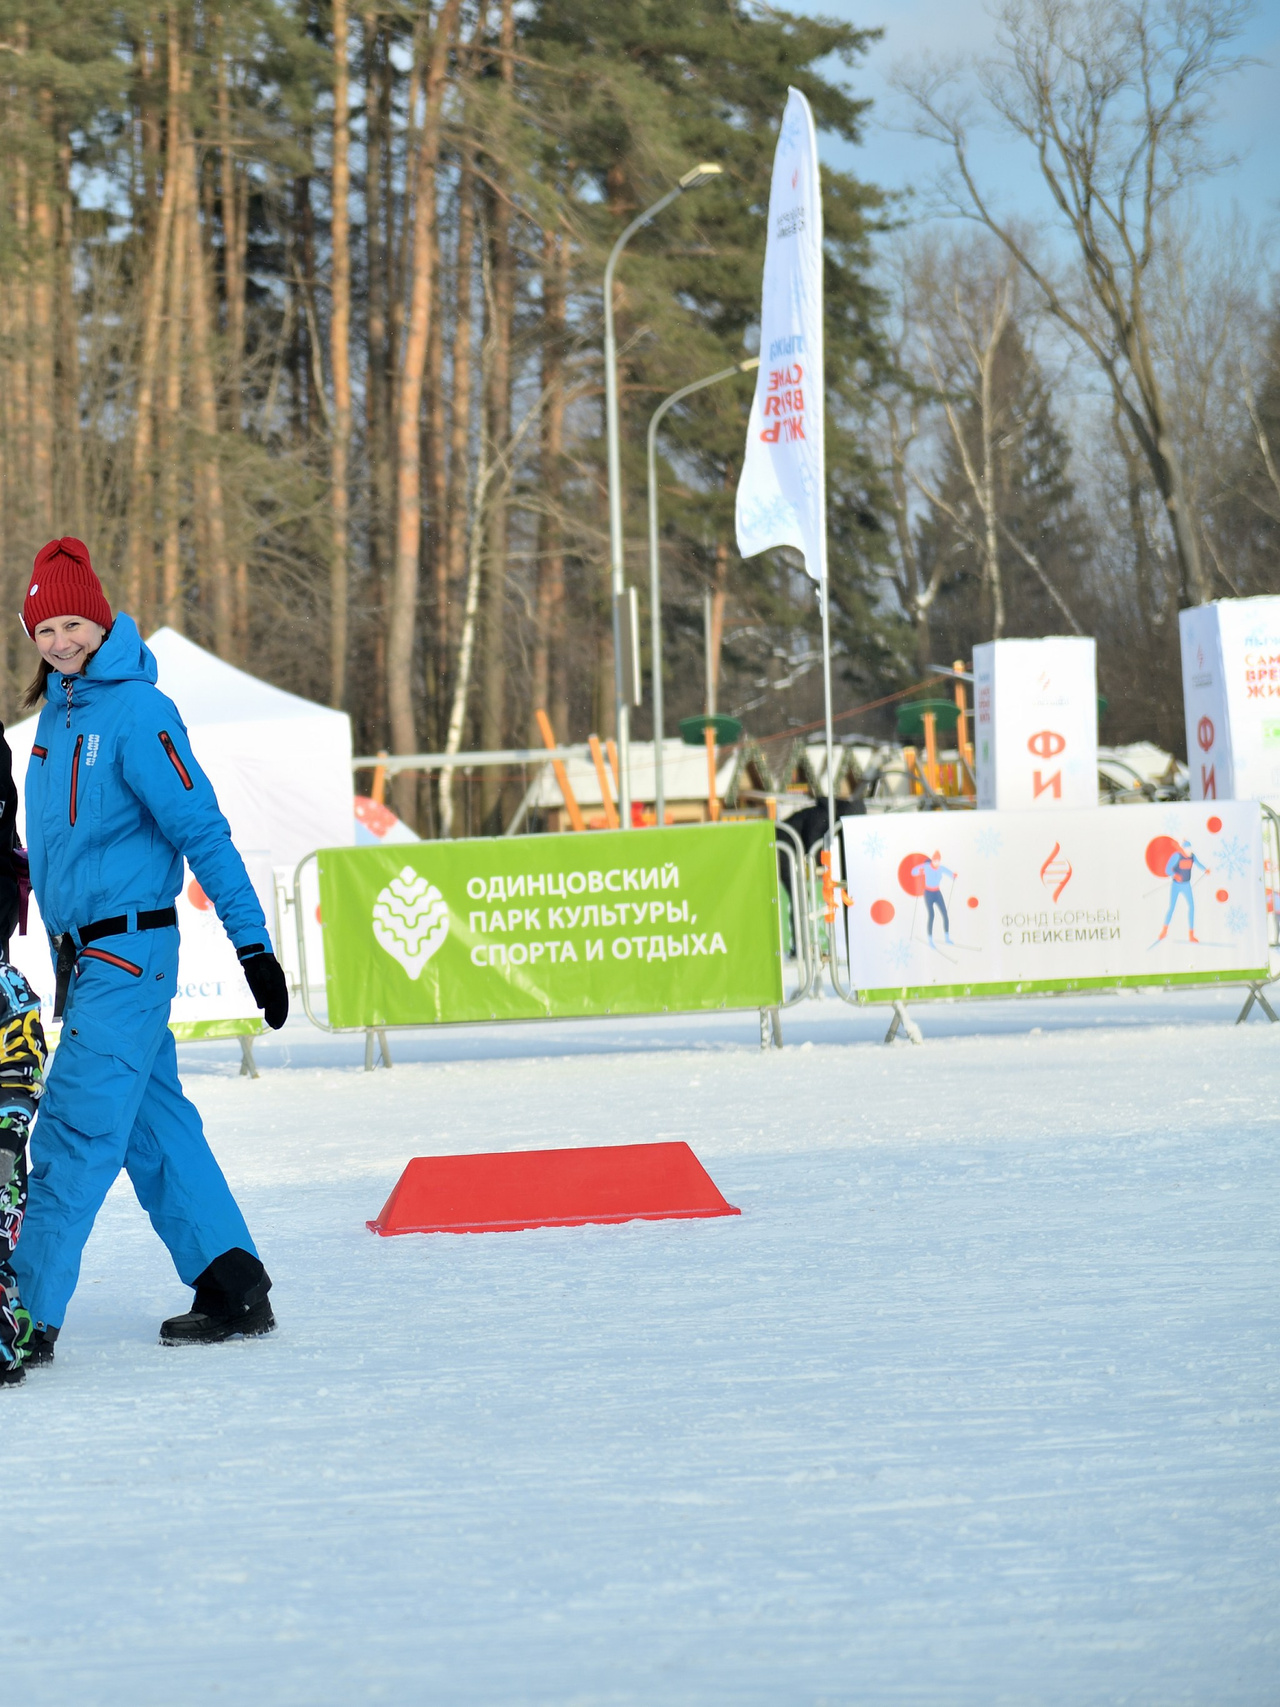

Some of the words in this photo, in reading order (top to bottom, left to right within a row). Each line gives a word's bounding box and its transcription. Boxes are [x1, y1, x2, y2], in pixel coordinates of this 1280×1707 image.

[466, 862, 680, 903] ОДИНЦОВСКИЙ
[469, 908, 541, 933] ПАРК
[548, 899, 698, 929] КУЛЬТУРЫ,
[1001, 911, 1048, 928] ФОНД
[1053, 908, 1120, 925] БОРЬБЫ
[470, 941, 578, 967] СПОРТА
[585, 938, 604, 962] И
[611, 932, 728, 963] ОТДЫХА
[1003, 931, 1013, 945] С
